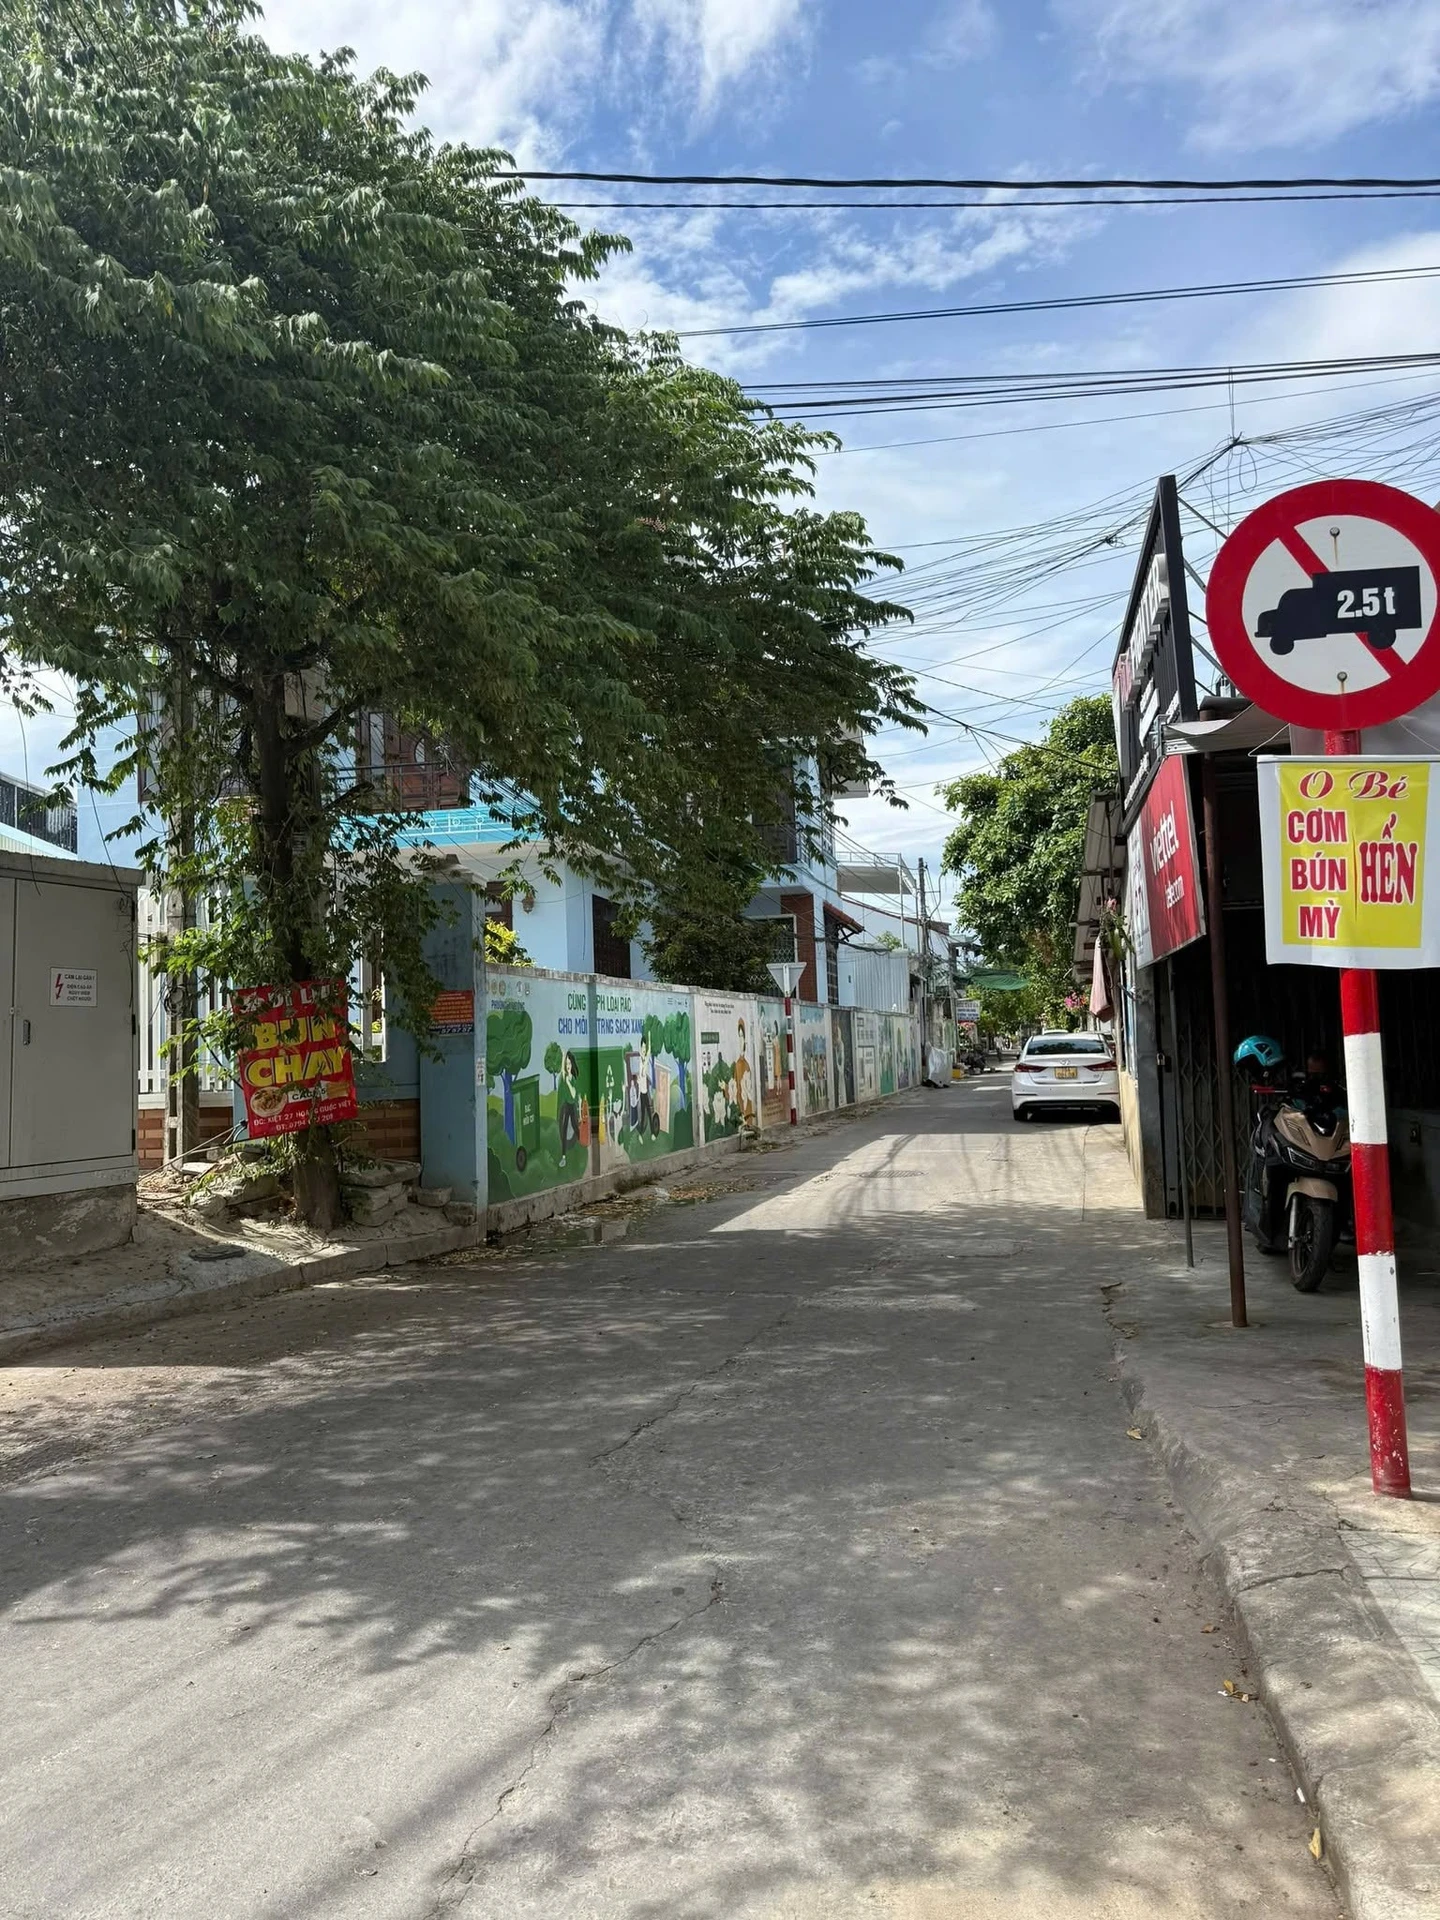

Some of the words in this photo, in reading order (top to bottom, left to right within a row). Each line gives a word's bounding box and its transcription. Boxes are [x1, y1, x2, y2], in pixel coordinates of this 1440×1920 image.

[1300, 769, 1334, 799] O
[1348, 770, 1410, 800] Bé
[1149, 800, 1179, 876] viettel
[1287, 807, 1348, 844] CƠM
[1290, 851, 1348, 892] BÚN
[1299, 899, 1341, 939] MỲ
[558, 1018, 572, 1034] CHO
[245, 1046, 346, 1087] CHAY
